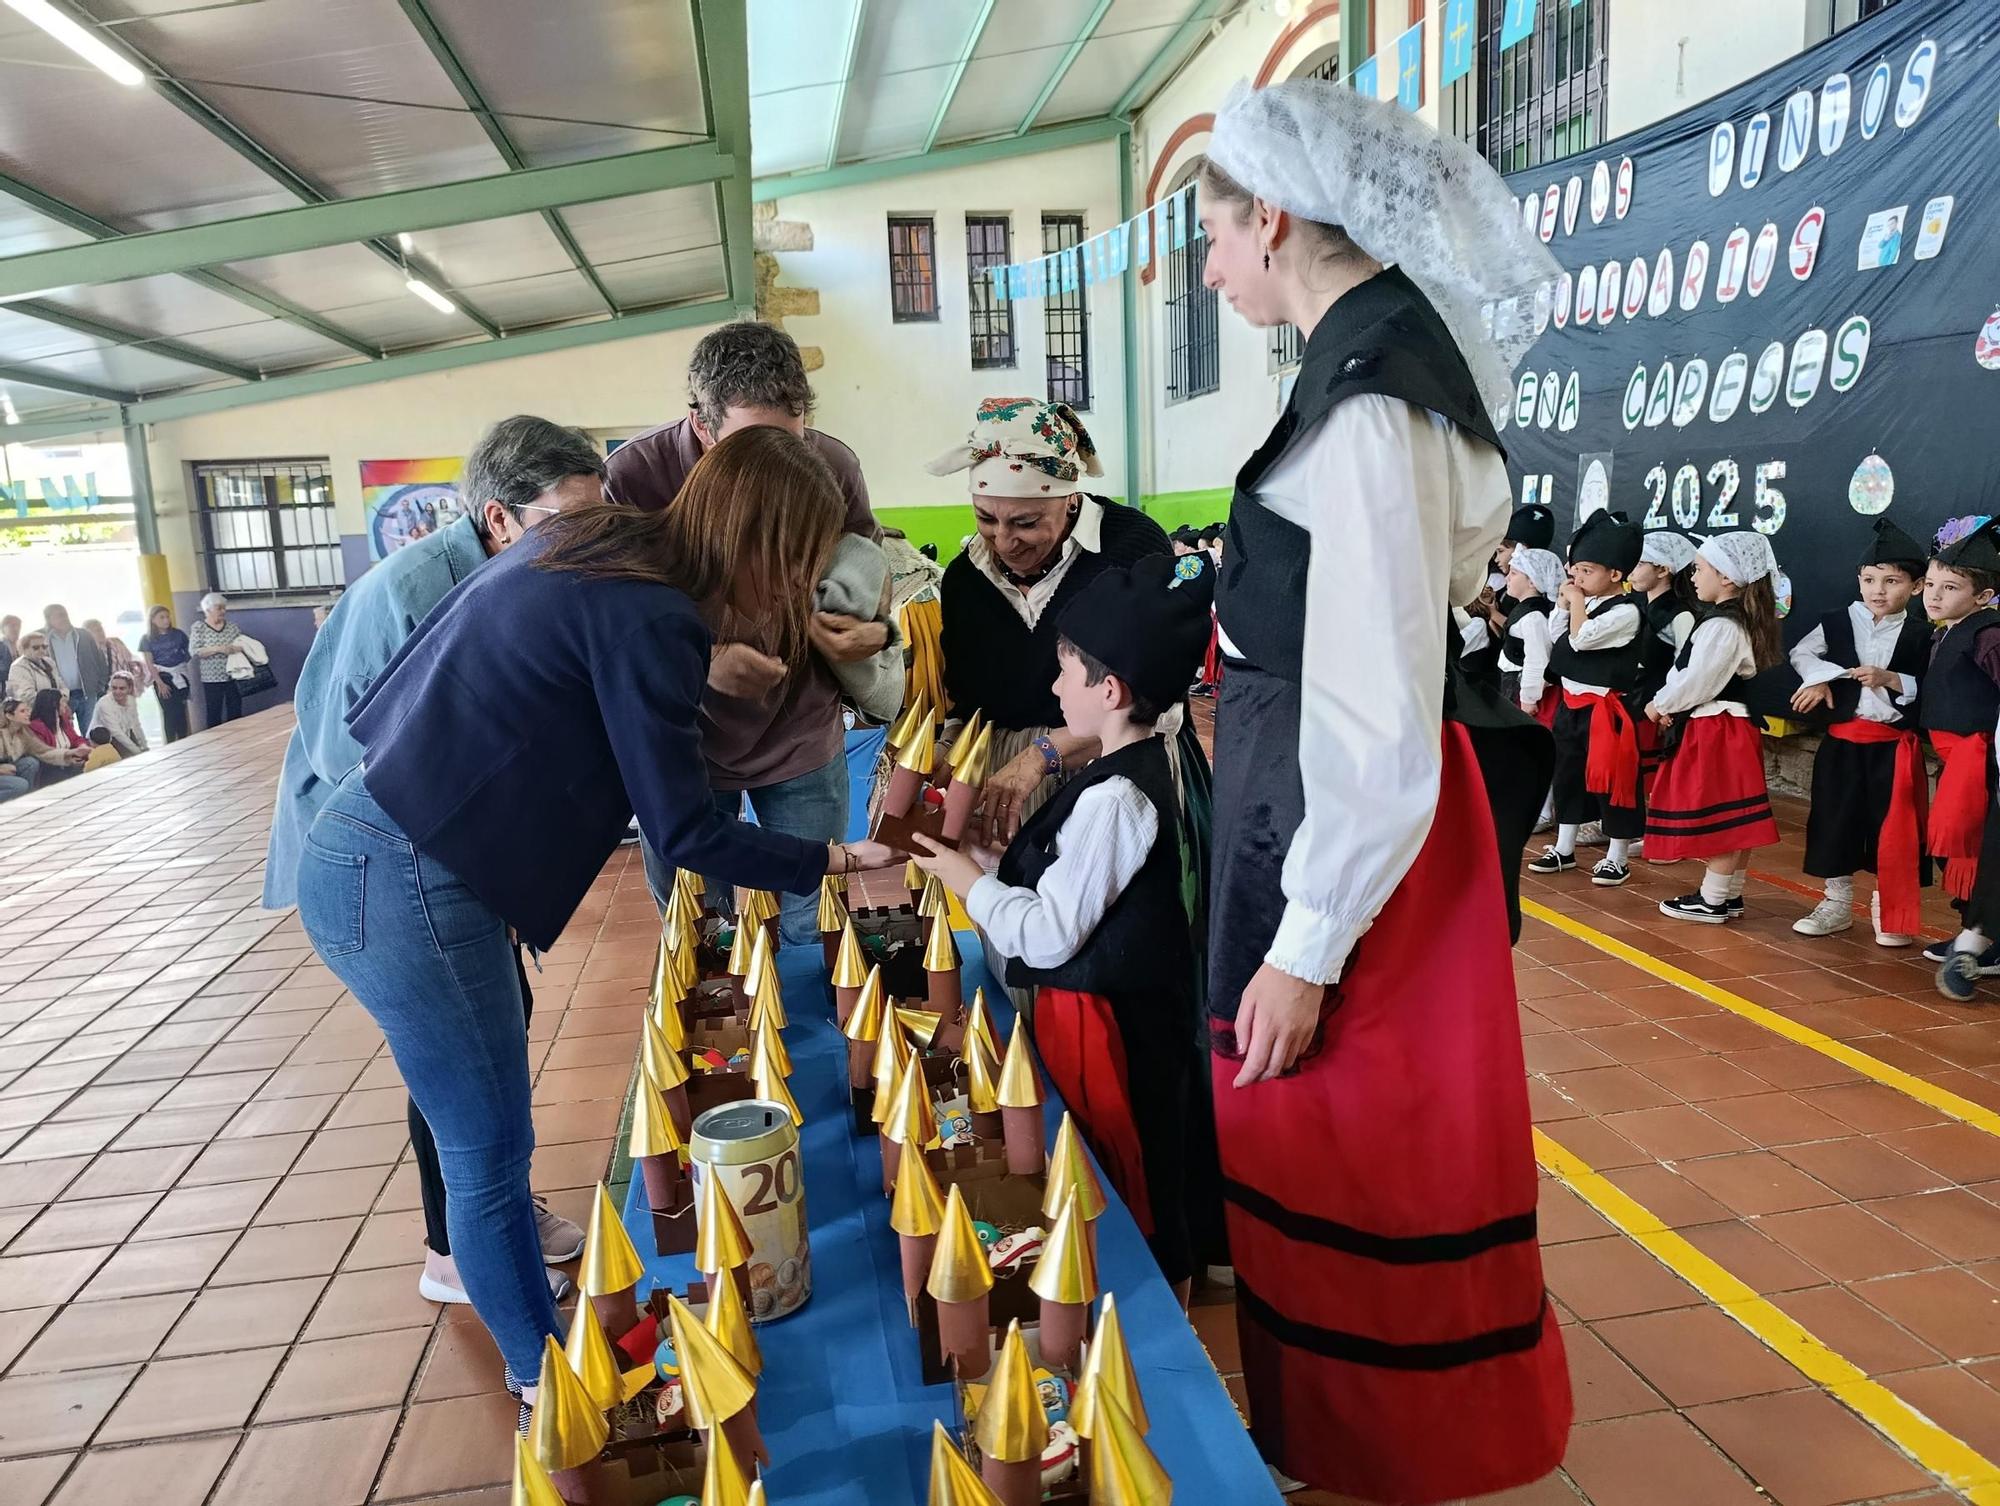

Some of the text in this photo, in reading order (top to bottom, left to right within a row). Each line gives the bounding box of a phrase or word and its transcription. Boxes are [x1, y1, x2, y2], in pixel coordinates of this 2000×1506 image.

[1710, 43, 1935, 195] PINTOS
[1500, 318, 1868, 430] EÑA CARESES
[1642, 459, 1787, 535] 2025
[740, 1150, 800, 1217] 20
